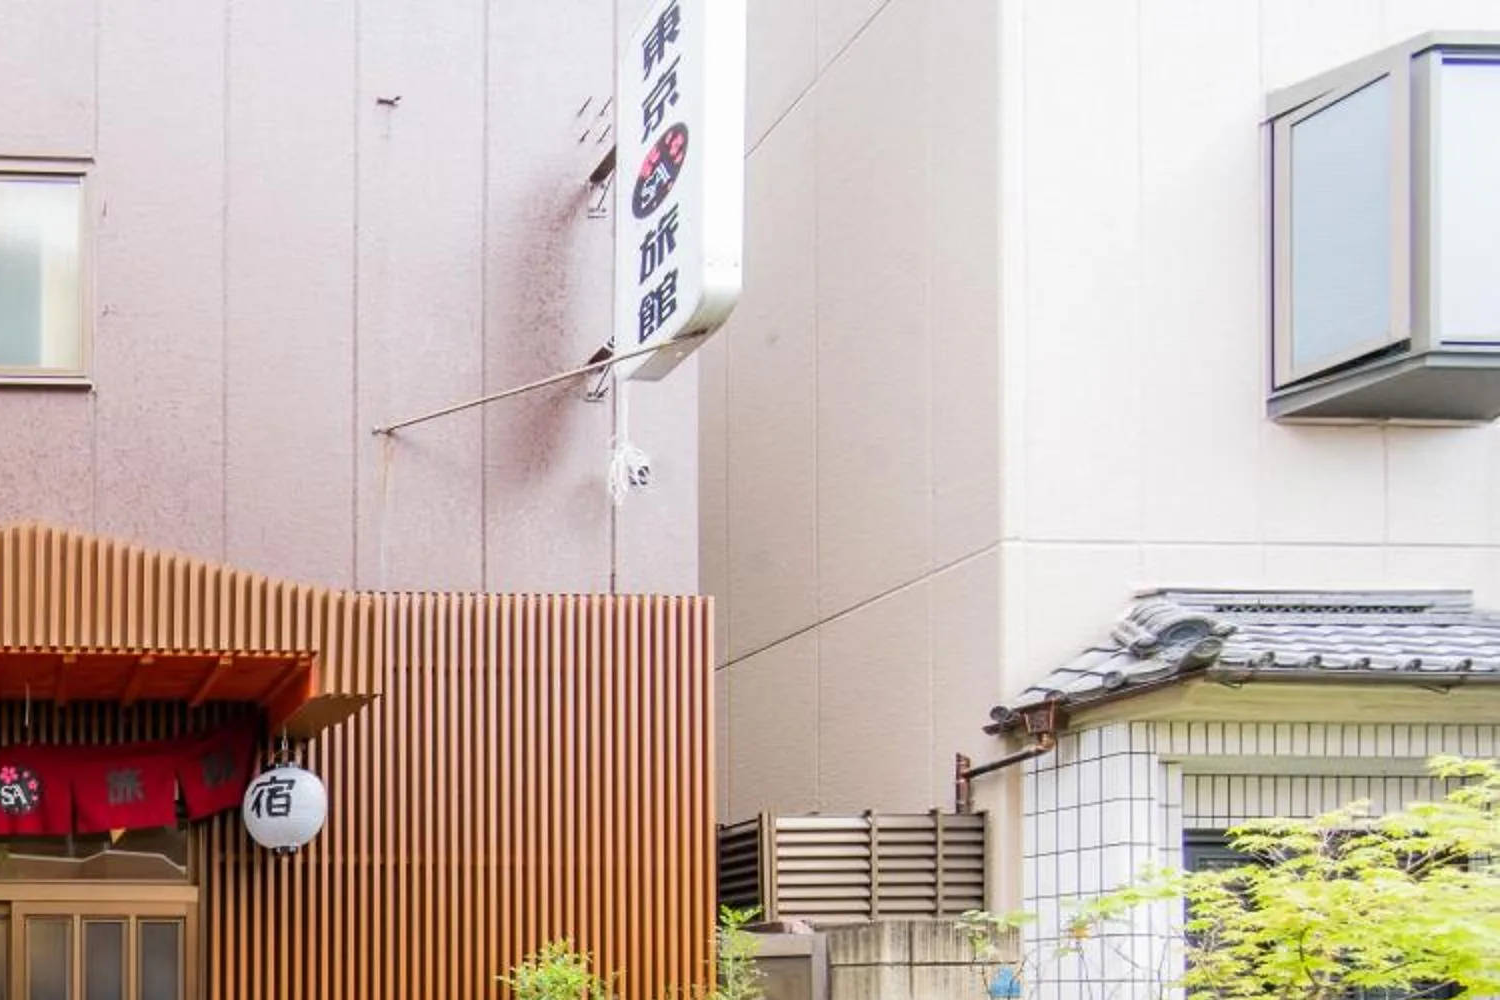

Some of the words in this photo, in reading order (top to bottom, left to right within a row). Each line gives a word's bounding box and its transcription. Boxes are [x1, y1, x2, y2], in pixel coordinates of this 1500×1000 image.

[642, 0, 681, 144] 東京
[638, 201, 679, 344] 旅館
[0, 783, 28, 805] SA
[251, 775, 296, 819] 宿
